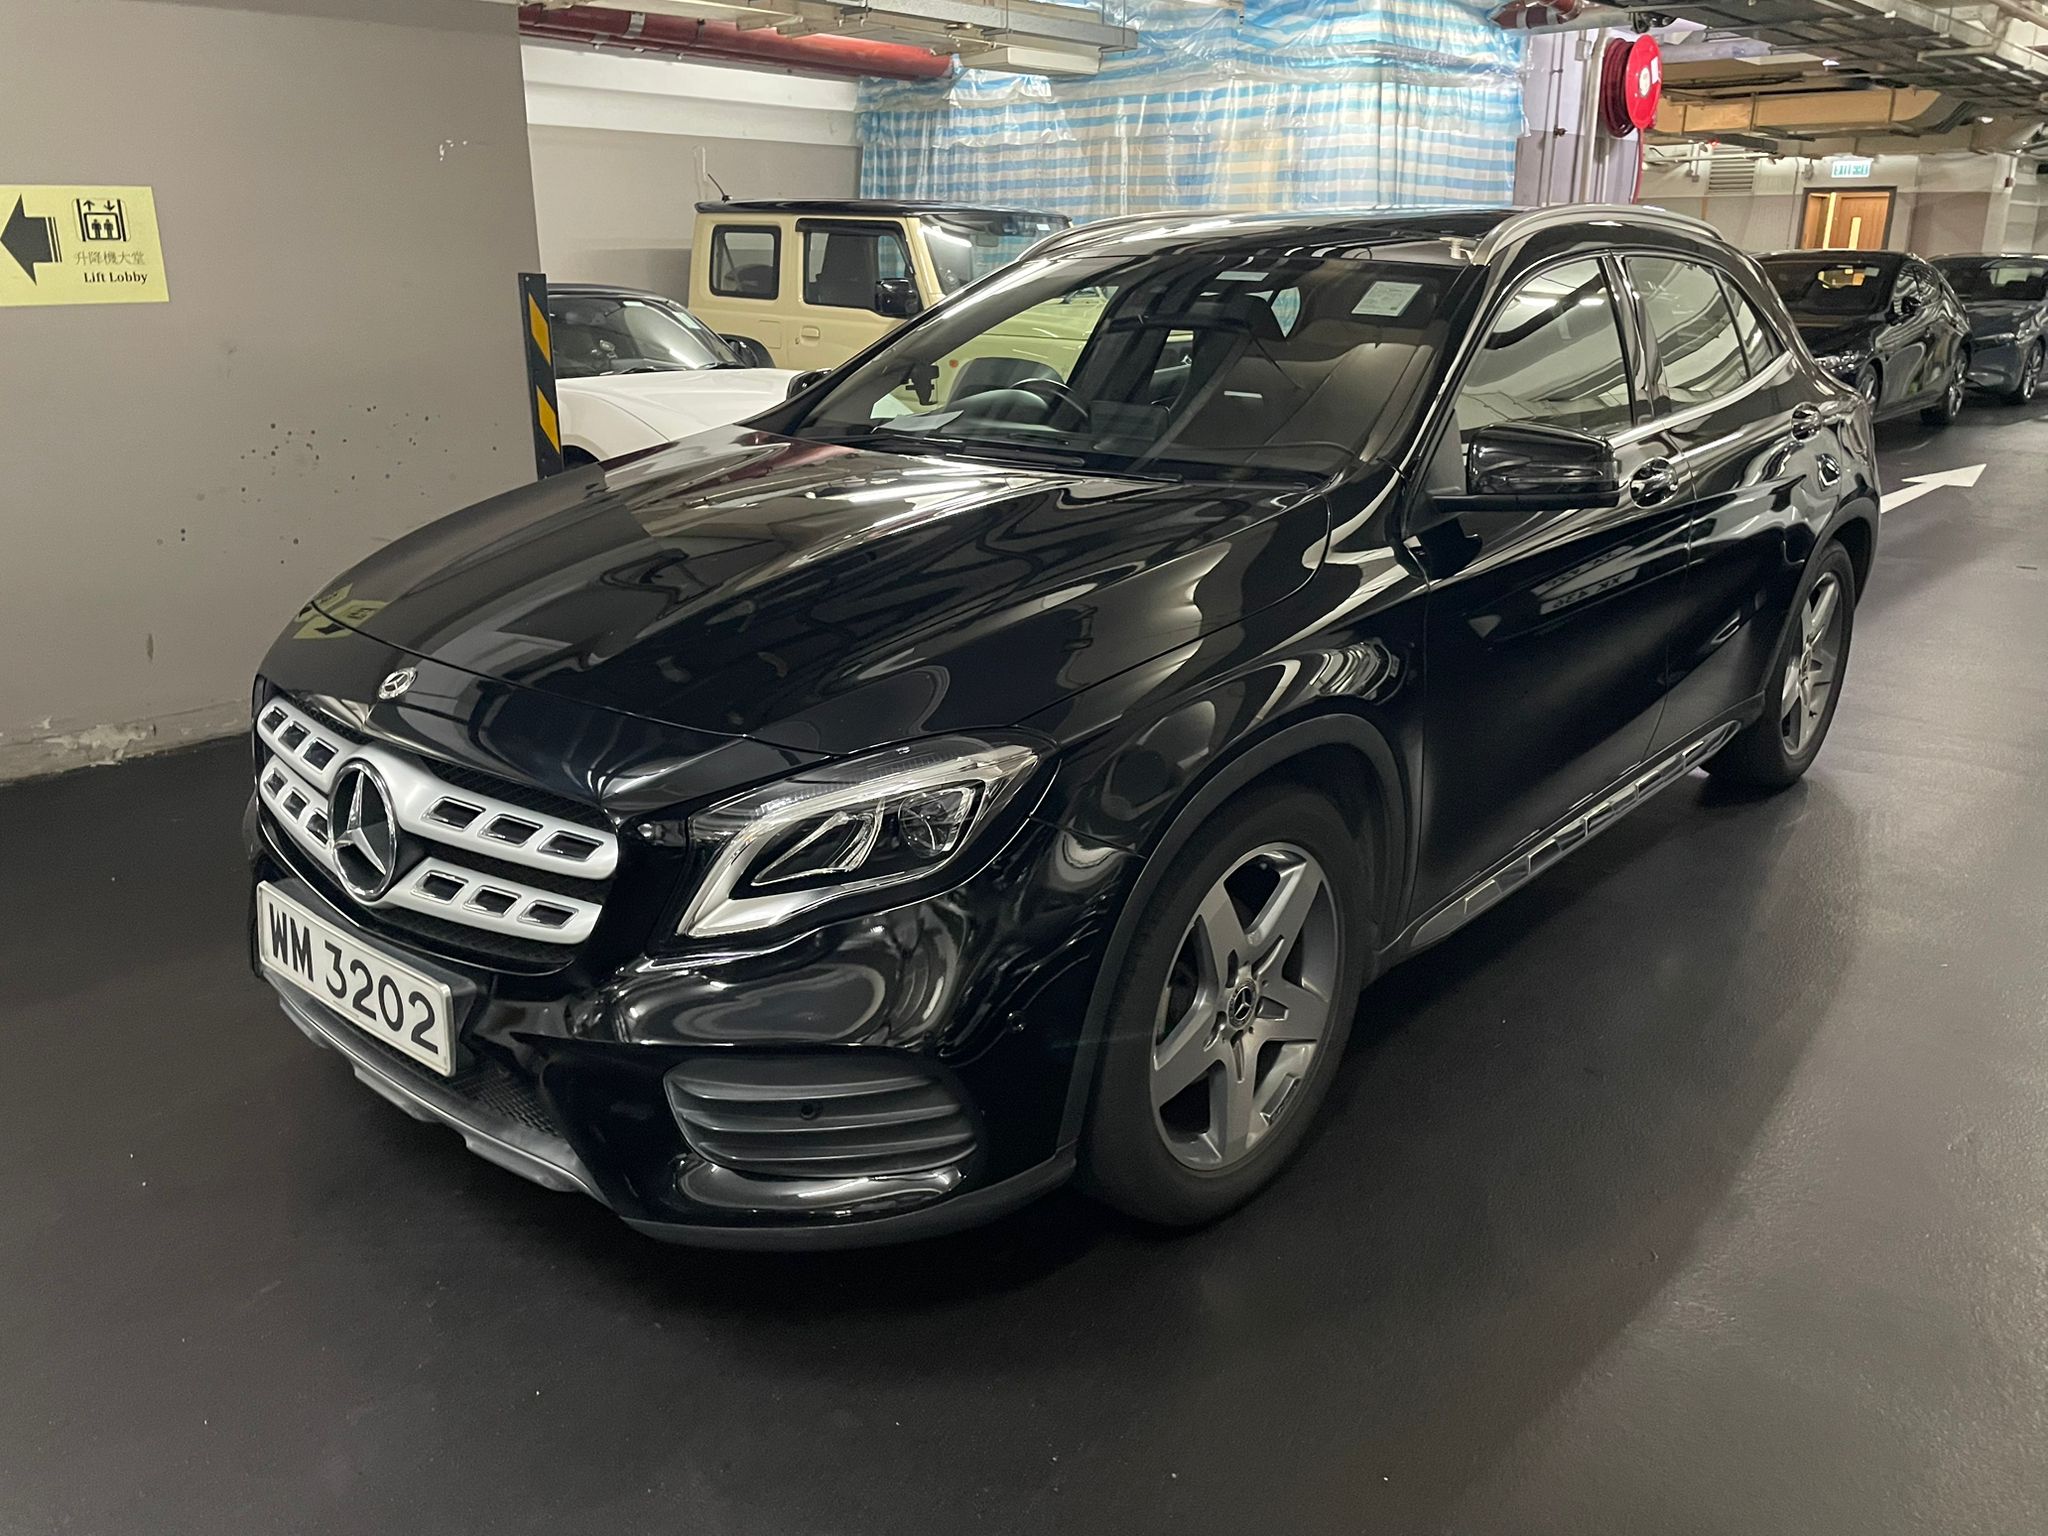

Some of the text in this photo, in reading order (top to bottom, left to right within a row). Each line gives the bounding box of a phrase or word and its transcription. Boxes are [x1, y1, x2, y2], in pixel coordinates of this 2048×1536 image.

[75, 250, 147, 266] 升降機大堂
[83, 271, 148, 285] Lift Lobby
[269, 902, 439, 1055] WM 3202
